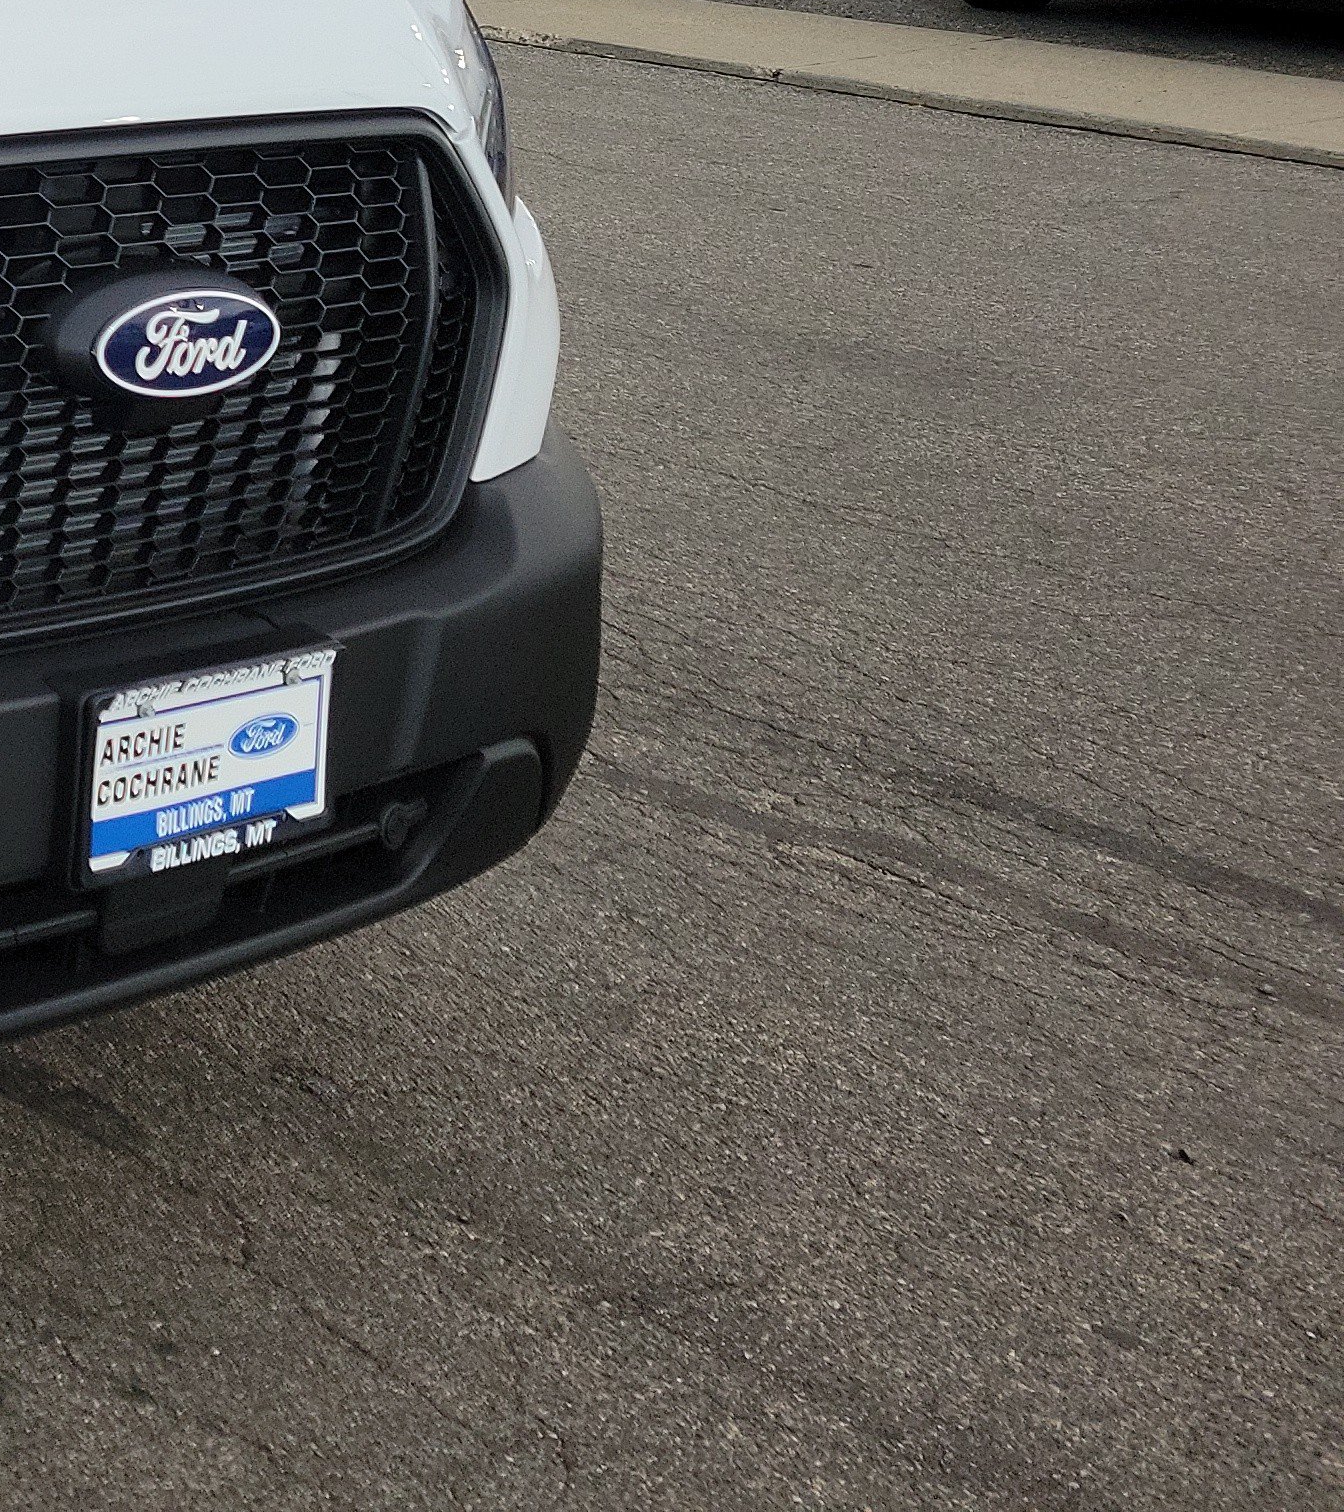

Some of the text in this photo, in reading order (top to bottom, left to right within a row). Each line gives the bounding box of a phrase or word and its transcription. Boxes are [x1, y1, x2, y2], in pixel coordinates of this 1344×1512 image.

[135, 308, 249, 381] Ford
[110, 649, 337, 712] ARCHIE COCHRANE FORD
[100, 722, 188, 769] ARCHIE
[240, 719, 285, 753] Ford
[96, 754, 221, 808] COCHRANE
[156, 787, 255, 838] BILLINGS, MT
[150, 819, 278, 873] BILLINGS, MT
